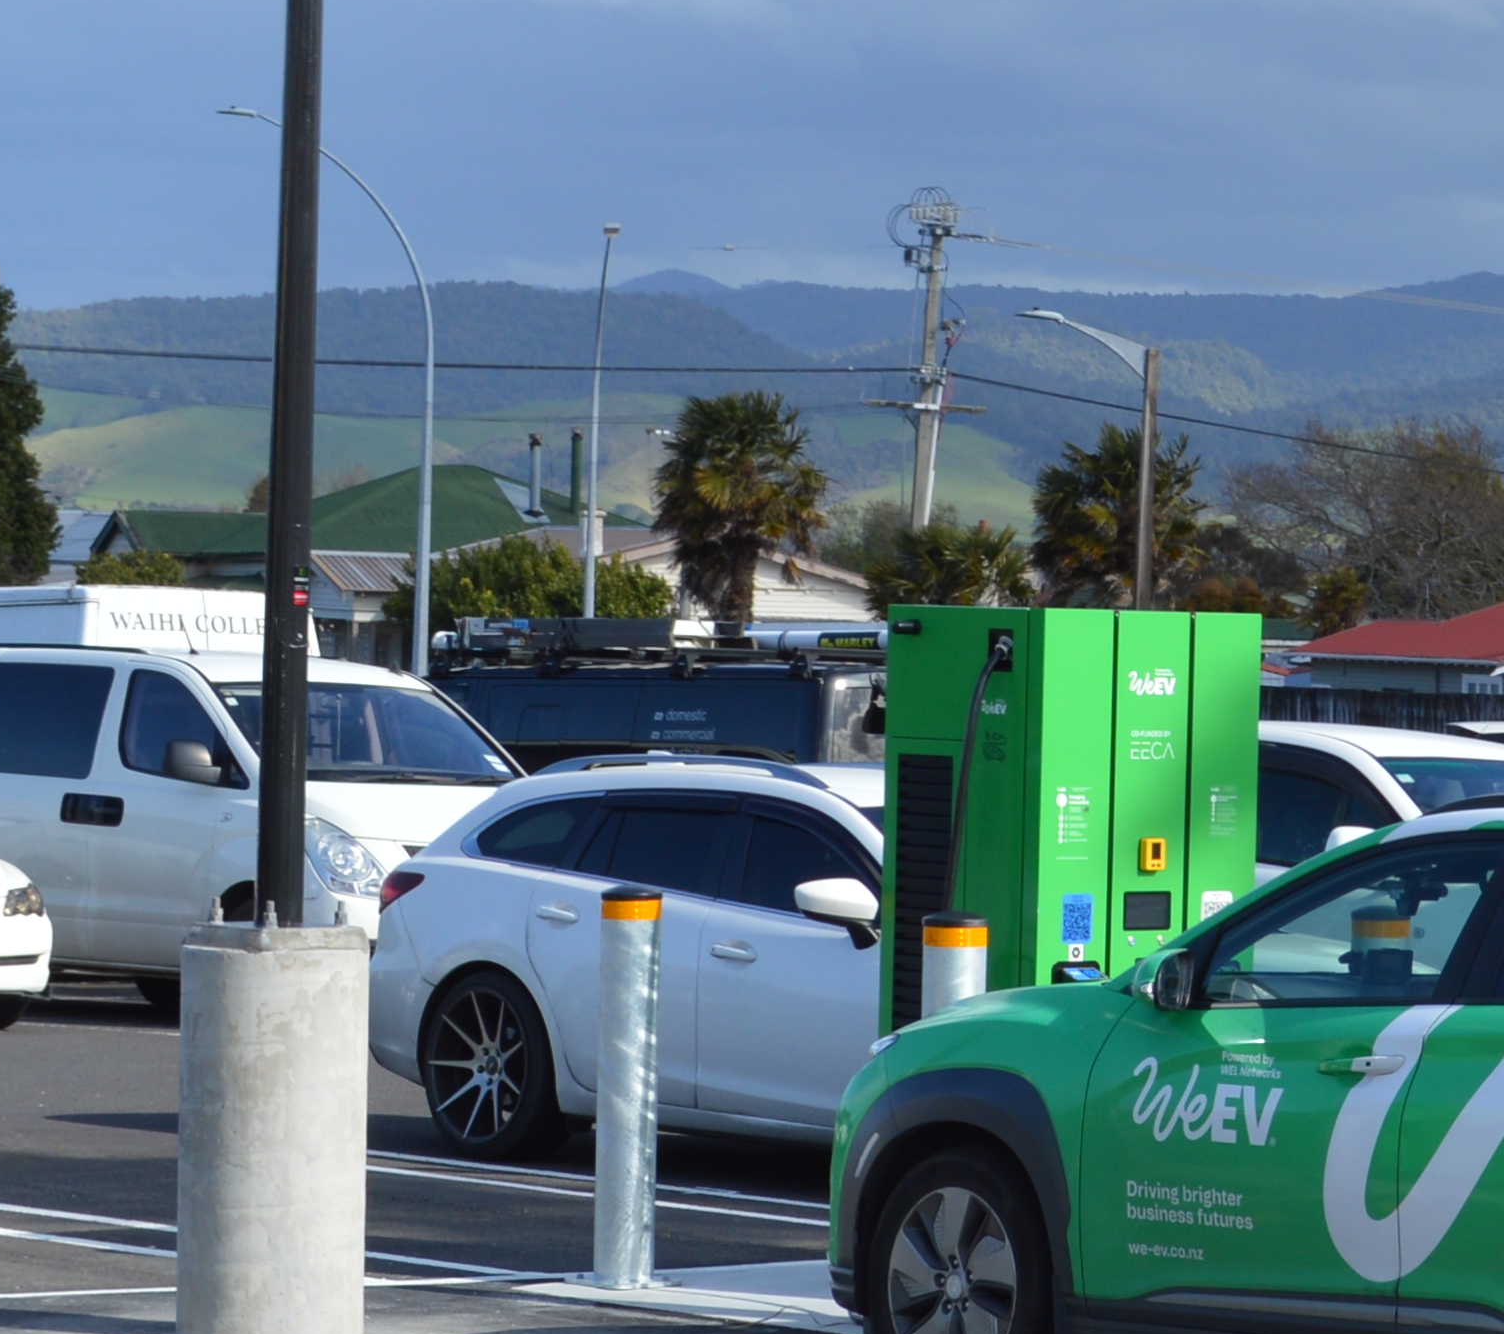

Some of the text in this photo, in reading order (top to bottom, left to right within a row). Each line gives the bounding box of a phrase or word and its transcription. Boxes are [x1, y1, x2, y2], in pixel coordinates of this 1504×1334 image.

[110, 611, 186, 632] WAIHI
[835, 637, 876, 648] MARLEY
[1127, 670, 1177, 696] WeEV
[666, 709, 707, 721] domestic
[663, 728, 715, 740] commercial
[1130, 741, 1175, 760] EECA
[1221, 1051, 1275, 1067] Powered by
[1220, 1064, 1281, 1079] WEL Networks
[1126, 1180, 1243, 1208] Driving brighter
[1126, 1202, 1254, 1230] business futures
[1128, 1242, 1205, 1261] we-ev.co.nz
